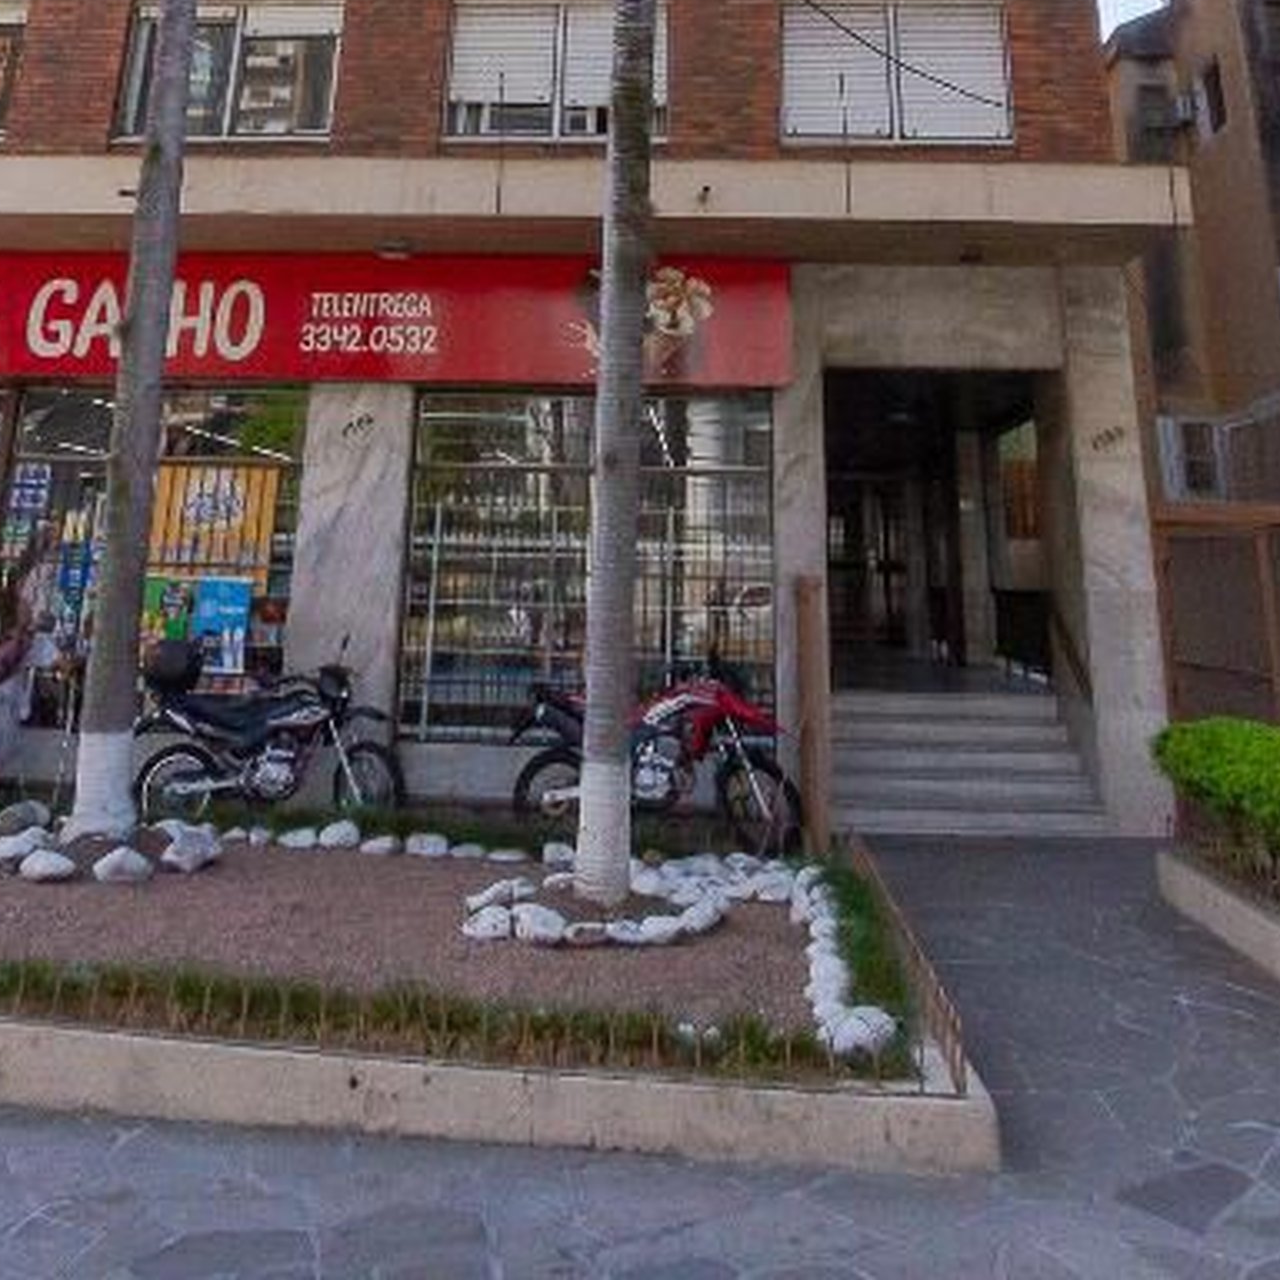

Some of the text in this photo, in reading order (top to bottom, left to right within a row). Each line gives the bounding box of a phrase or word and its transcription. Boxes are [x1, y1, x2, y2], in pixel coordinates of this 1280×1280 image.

[25, 277, 266, 362] GAHO
[310, 291, 434, 319] TELENTREGA
[298, 323, 440, 354] 3342.0532
